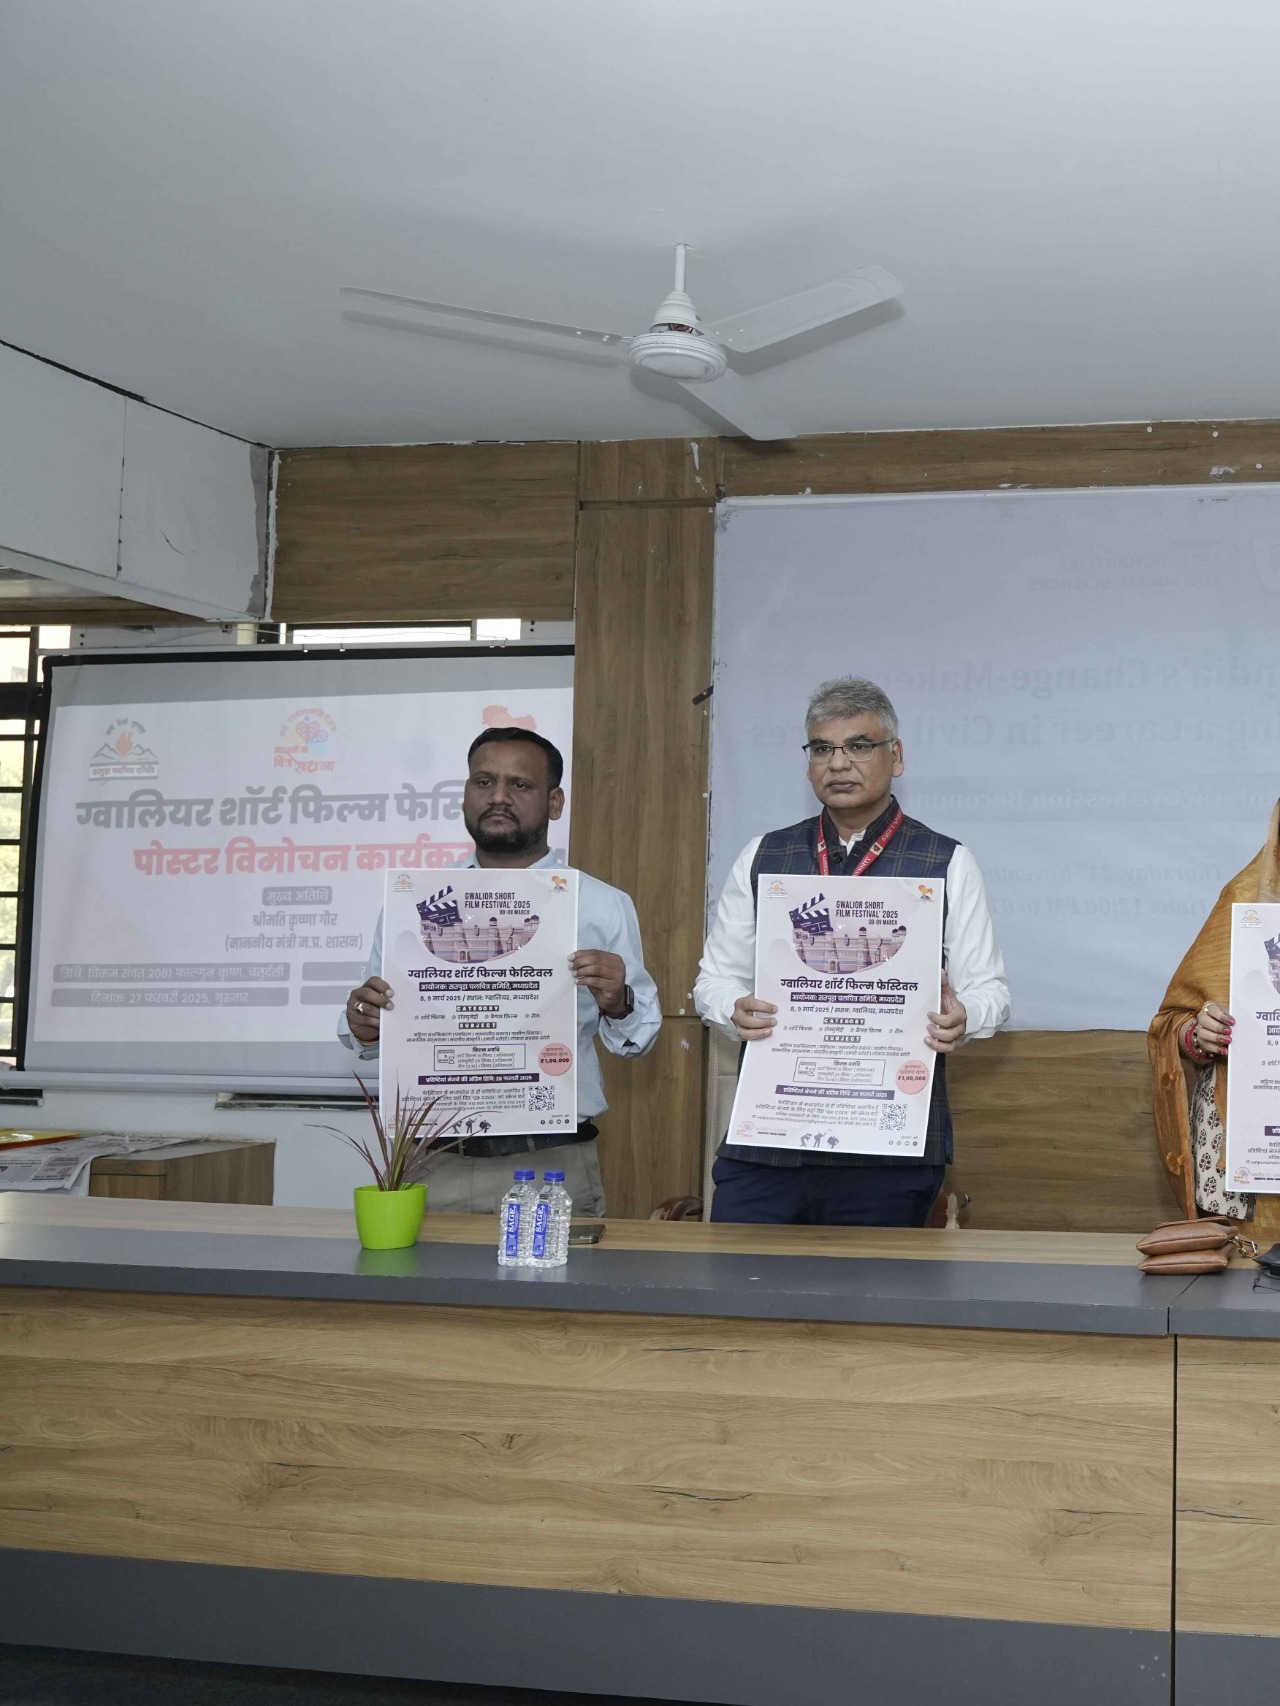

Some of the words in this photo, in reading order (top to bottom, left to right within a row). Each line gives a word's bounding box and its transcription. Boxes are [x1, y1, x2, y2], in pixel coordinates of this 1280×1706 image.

[75, 788, 214, 829] ग्वालियर
[219, 785, 288, 827] शॉर्ट
[289, 783, 389, 824] फिल्म
[134, 840, 220, 876] पोस्टर
[225, 836, 350, 875] विमोचन
[267, 892, 291, 905] मुख्य
[296, 889, 329, 902] अतिथि
[837, 901, 862, 909] GWALIOR
[864, 901, 884, 909] SHORT
[252, 910, 285, 927] श्रीमति
[288, 912, 316, 931] कृष्णा
[319, 910, 338, 926] गौर
[408, 967, 452, 979] ग्वालियर
[455, 967, 475, 978] शॉर्ट
[477, 967, 506, 978] फिल्म
[509, 966, 553, 978] फेस्टिवल
[781, 977, 822, 989] ग्वालियर
[825, 977, 843, 989] शॉर्ट
[846, 978, 874, 990] फिल्म
[876, 979, 918, 991] फेस्टिवल
[130, 993, 142, 1004] 27
[535, 1208, 544, 1233] SAGE
